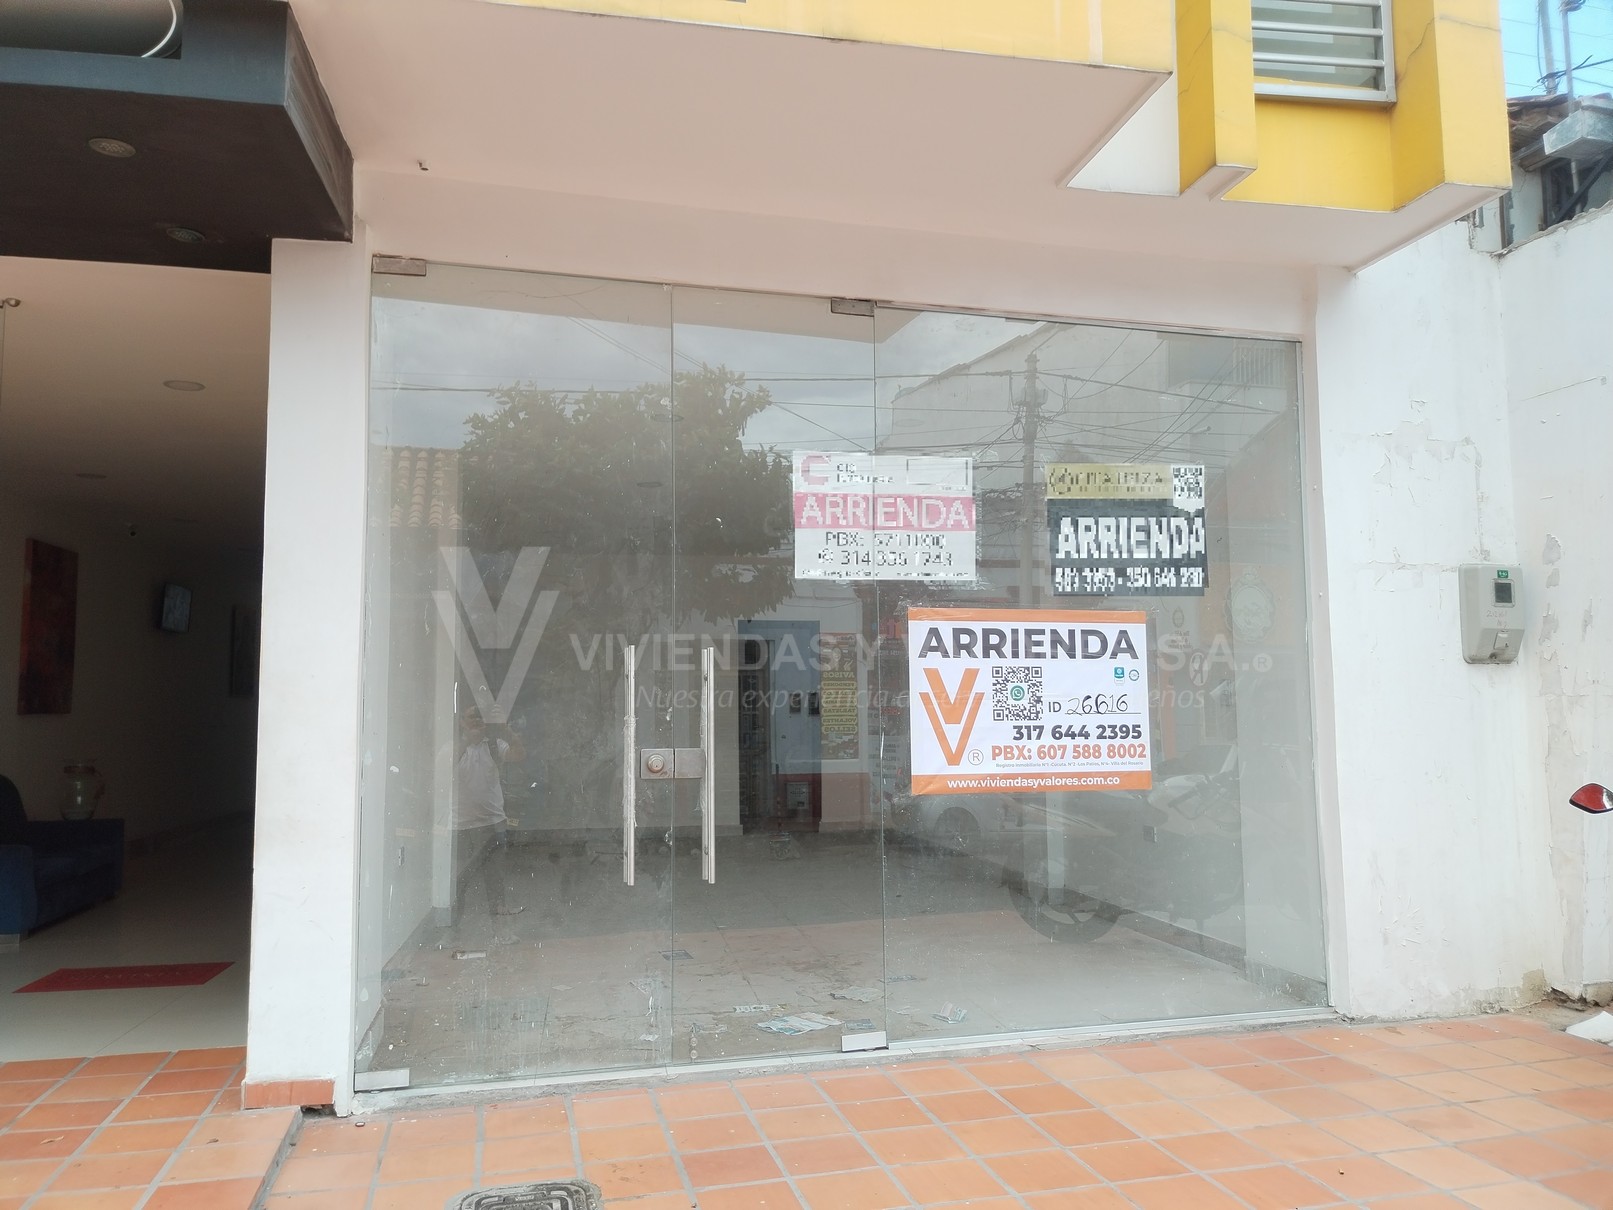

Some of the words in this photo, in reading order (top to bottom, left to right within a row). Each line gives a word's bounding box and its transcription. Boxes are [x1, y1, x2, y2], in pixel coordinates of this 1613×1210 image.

[800, 496, 970, 529] ARRIENDA
[1055, 516, 1205, 559] ARRIENDA
[917, 627, 1140, 660] ARRIENDA
[1048, 701, 1062, 713] ID
[1012, 724, 1045, 741] 317
[1051, 724, 1091, 741] 644
[1095, 724, 1142, 740] 2395
[991, 744, 1032, 761] PBX:
[1036, 744, 1068, 761] 607
[1072, 743, 1102, 760] 588
[1106, 743, 1147, 759] 8002
[947, 775, 1120, 789] www.viviendasyvalores.com.co
